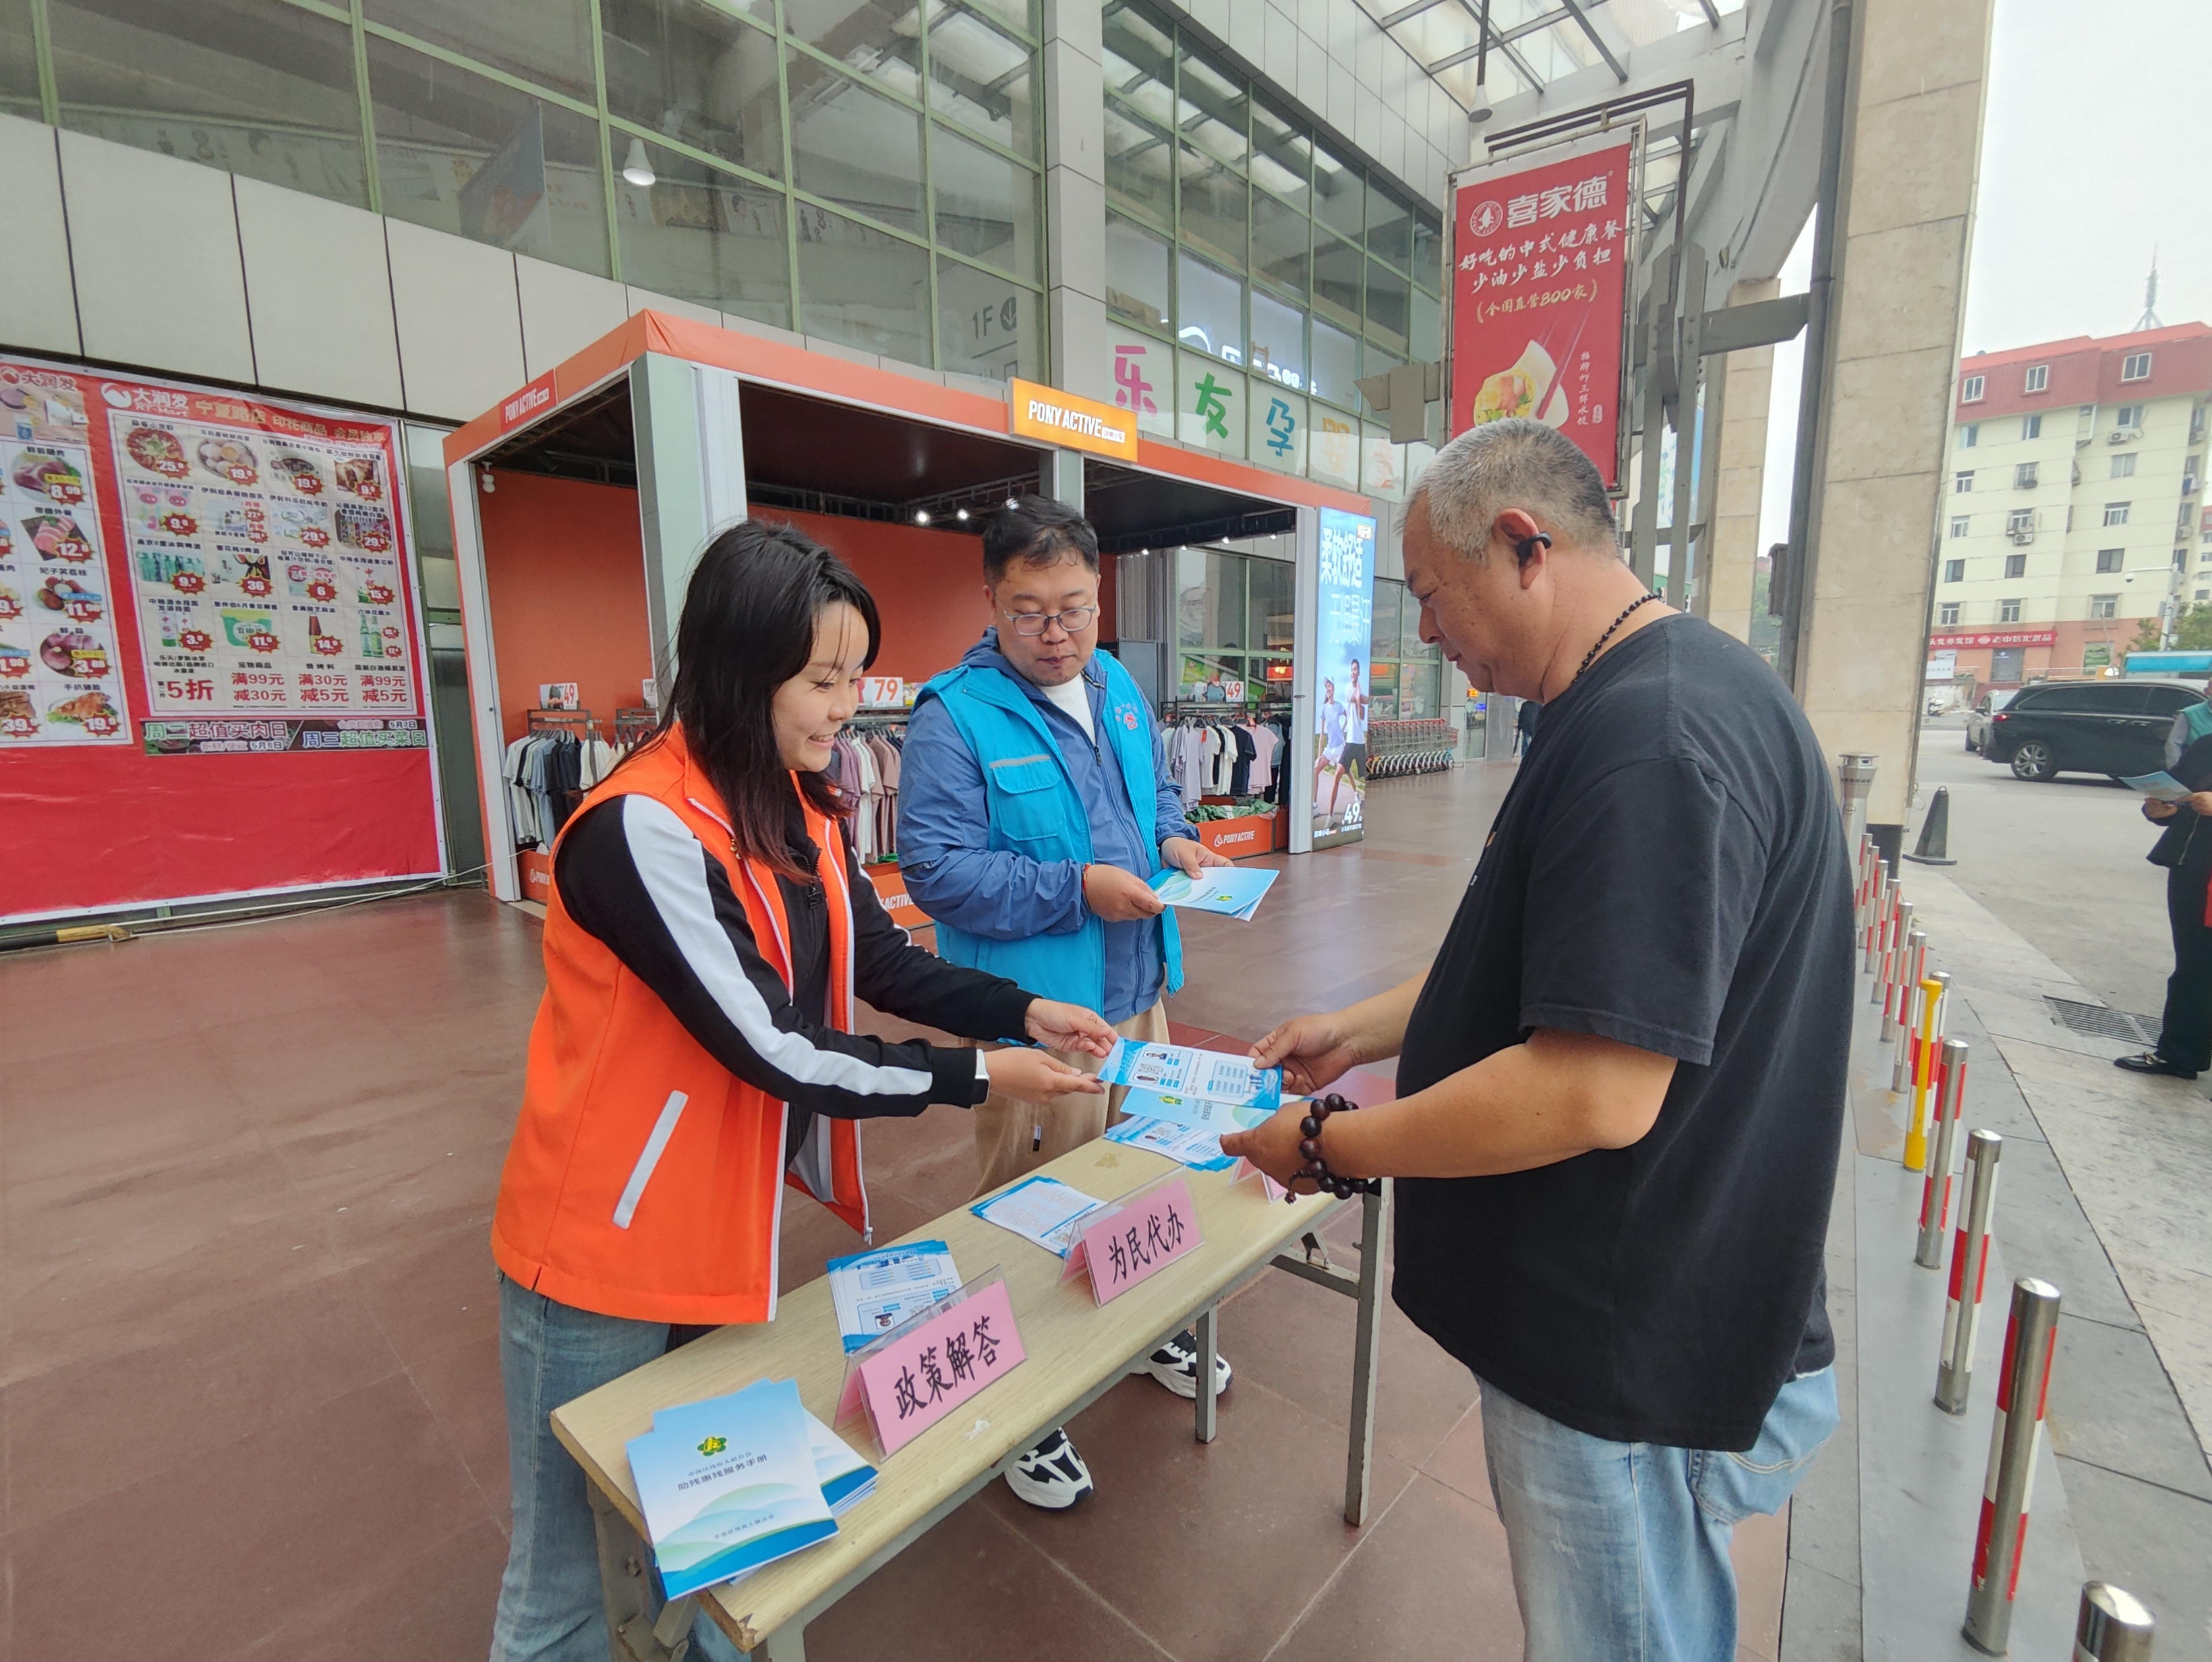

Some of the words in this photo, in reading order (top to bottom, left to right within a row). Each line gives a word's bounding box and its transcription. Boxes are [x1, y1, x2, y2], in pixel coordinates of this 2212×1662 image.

[1507, 175, 1607, 229] 喜家德
[1459, 220, 1623, 270] 好吃的中式健康餐
[1472, 247, 1611, 294] 少油少盐少负担
[972, 305, 993, 339] 1F
[23, 372, 77, 391] 大润发
[134, 388, 189, 407] 大润发
[519, 389, 537, 414] ACTIVE
[196, 401, 266, 424] 宁夏路店
[272, 415, 327, 436] 印花商品
[1028, 399, 1062, 427] PONY
[1062, 409, 1103, 437] ACTIVE
[1320, 527, 1363, 588] 柔软舒适
[247, 581, 264, 591] 36
[316, 586, 326, 596] 6
[231, 672, 285, 685] 满99元
[298, 673, 348, 686] 满30元
[360, 675, 406, 687] 满99元
[167, 679, 214, 701] 5折
[233, 689, 287, 701] 减30元
[300, 688, 349, 702] 减5元
[362, 689, 407, 702] 减5元
[563, 684, 575, 704] 49
[874, 679, 898, 701] 79
[1227, 683, 1240, 697] 49
[145, 722, 289, 741] 周二超值买肉日
[303, 730, 428, 748] 周三超值买菜日
[1344, 803, 1360, 824] 49
[1237, 830, 1256, 842] ACTIVE
[1109, 1204, 1184, 1284] 为民代办
[894, 1315, 1000, 1419] 政策解答
[678, 1454, 767, 1491] 助残惠残服务手册
